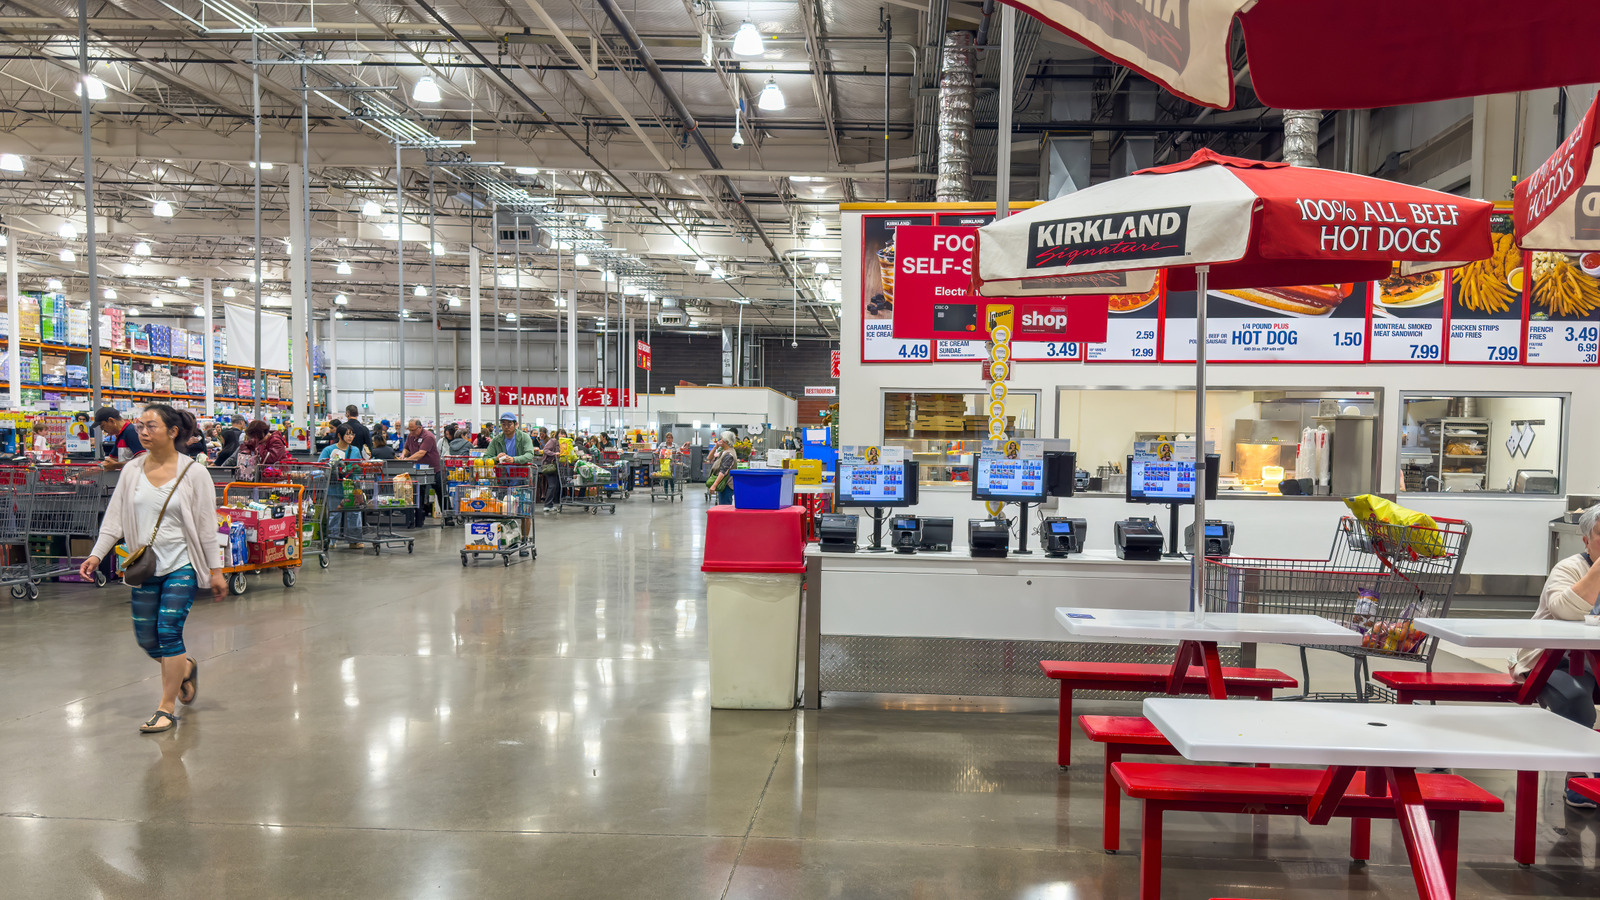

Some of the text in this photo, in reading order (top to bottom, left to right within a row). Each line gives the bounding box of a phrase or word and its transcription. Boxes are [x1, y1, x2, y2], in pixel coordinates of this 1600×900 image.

[1296, 198, 1459, 225] 100% ALL BEEF
[1036, 212, 1181, 248] KIRKLAND
[934, 234, 975, 252] FOO
[1320, 226, 1441, 253] HOT DOGS
[1036, 240, 1178, 267] Signature
[902, 257, 972, 275] SELF-S
[988, 309, 1011, 322] Interac
[1022, 311, 1067, 330] shop
[1136, 331, 1155, 340] 2.59
[1232, 331, 1298, 345] HOT DOG
[1333, 332, 1362, 346] 1.50
[1565, 327, 1598, 342] 3.49
[899, 344, 928, 358] 4.49
[1047, 343, 1077, 356] 3.49
[1132, 348, 1154, 357] 12.99
[1410, 344, 1439, 359] 7.99
[1487, 346, 1518, 361] 7.99
[1578, 343, 1598, 352] 6.99
[1583, 354, 1597, 362] .30
[509, 393, 584, 406] PHARMAY
